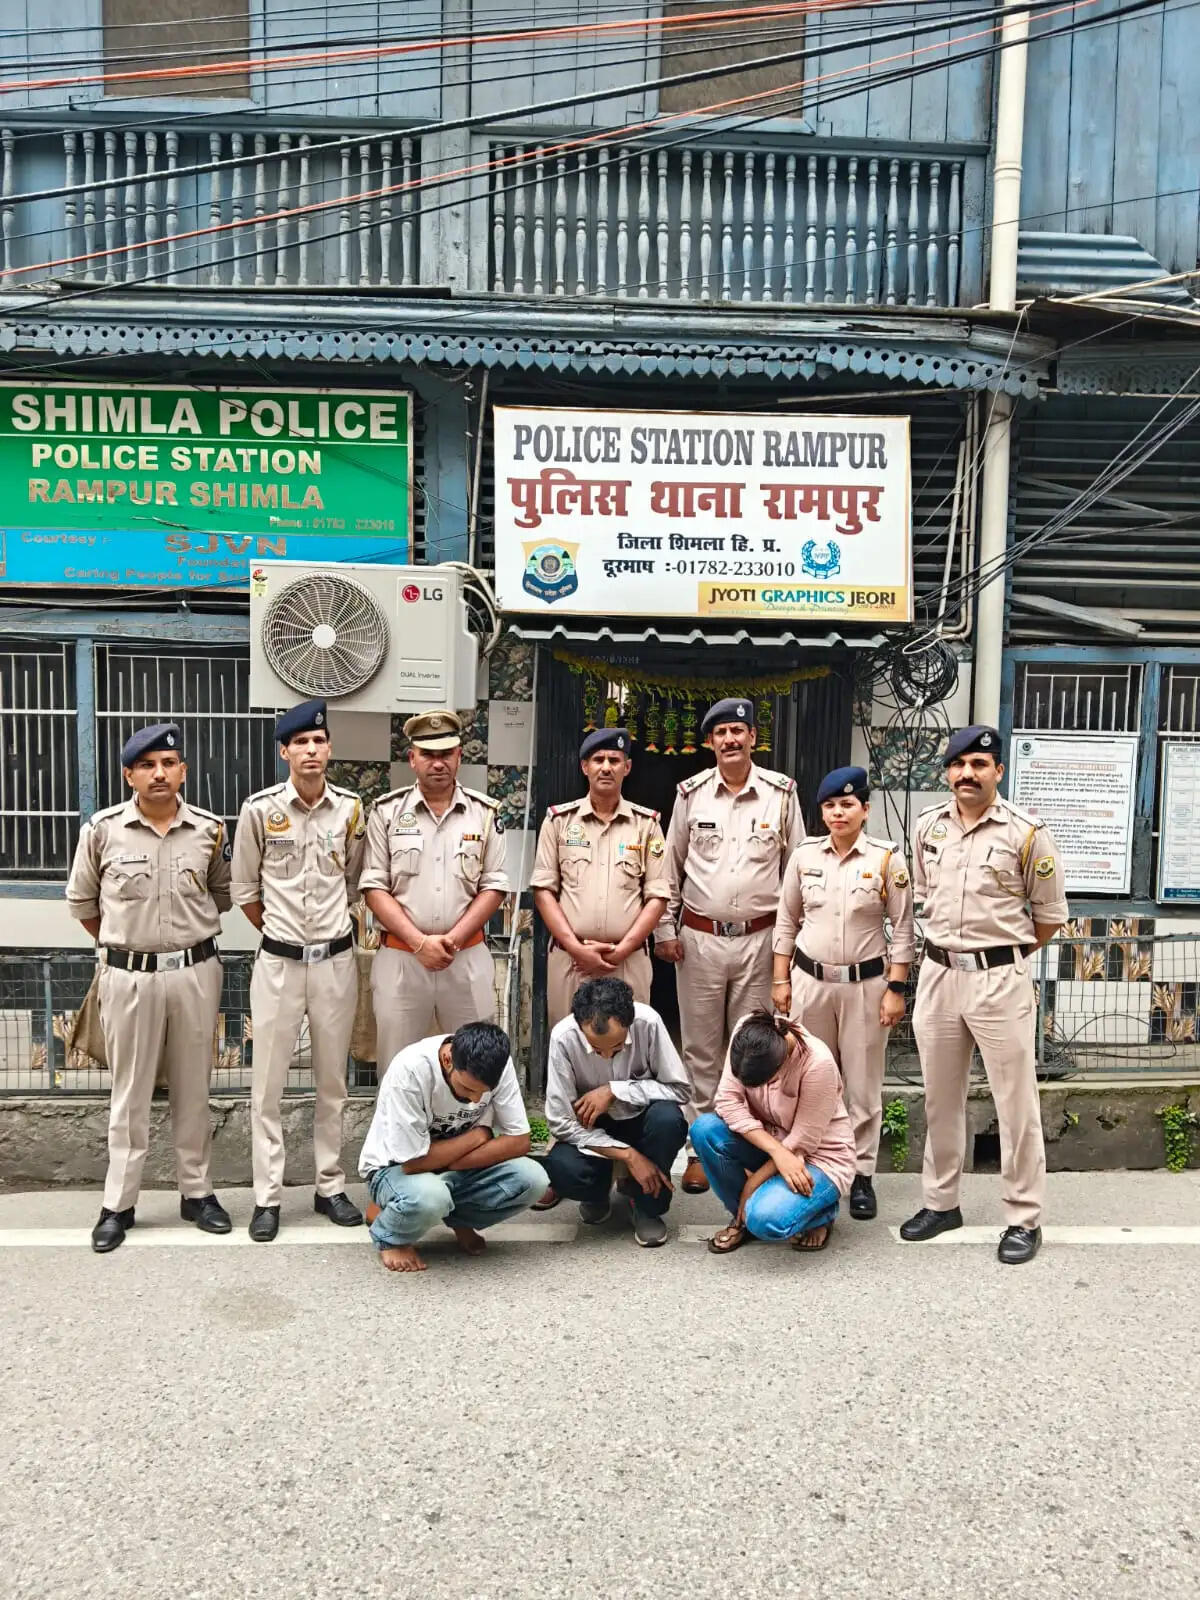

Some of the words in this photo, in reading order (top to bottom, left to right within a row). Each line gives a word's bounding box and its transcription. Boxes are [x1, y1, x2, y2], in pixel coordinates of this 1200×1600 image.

[11, 394, 203, 436] SHIMLA
[218, 400, 398, 440] POLICE
[513, 424, 621, 465] POLICE
[630, 427, 754, 467] STATION
[763, 430, 888, 469] RAMPUR
[31, 443, 159, 471] POLICE
[170, 446, 322, 475] STATION
[28, 478, 178, 507] RAMPUR
[190, 482, 325, 510] SHIMLA
[507, 468, 632, 528] पुलिस
[650, 480, 746, 519] थाना
[760, 483, 885, 535] रामपुर
[21, 531, 97, 545] Courtesy
[165, 533, 287, 556] SJVN
[617, 532, 663, 550] जिला
[668, 533, 725, 551] शिमला
[731, 534, 754, 553] हि.
[762, 538, 782, 553] प्र.
[178, 556, 250, 569] Foundat
[602, 559, 655, 577] दूरभाष
[64, 567, 119, 580] Caring
[126, 568, 182, 581] People
[423, 587, 443, 601] LG
[709, 588, 756, 604] JYOTI
[761, 589, 845, 604] GRAPHICS
[848, 591, 896, 607] JEORI
